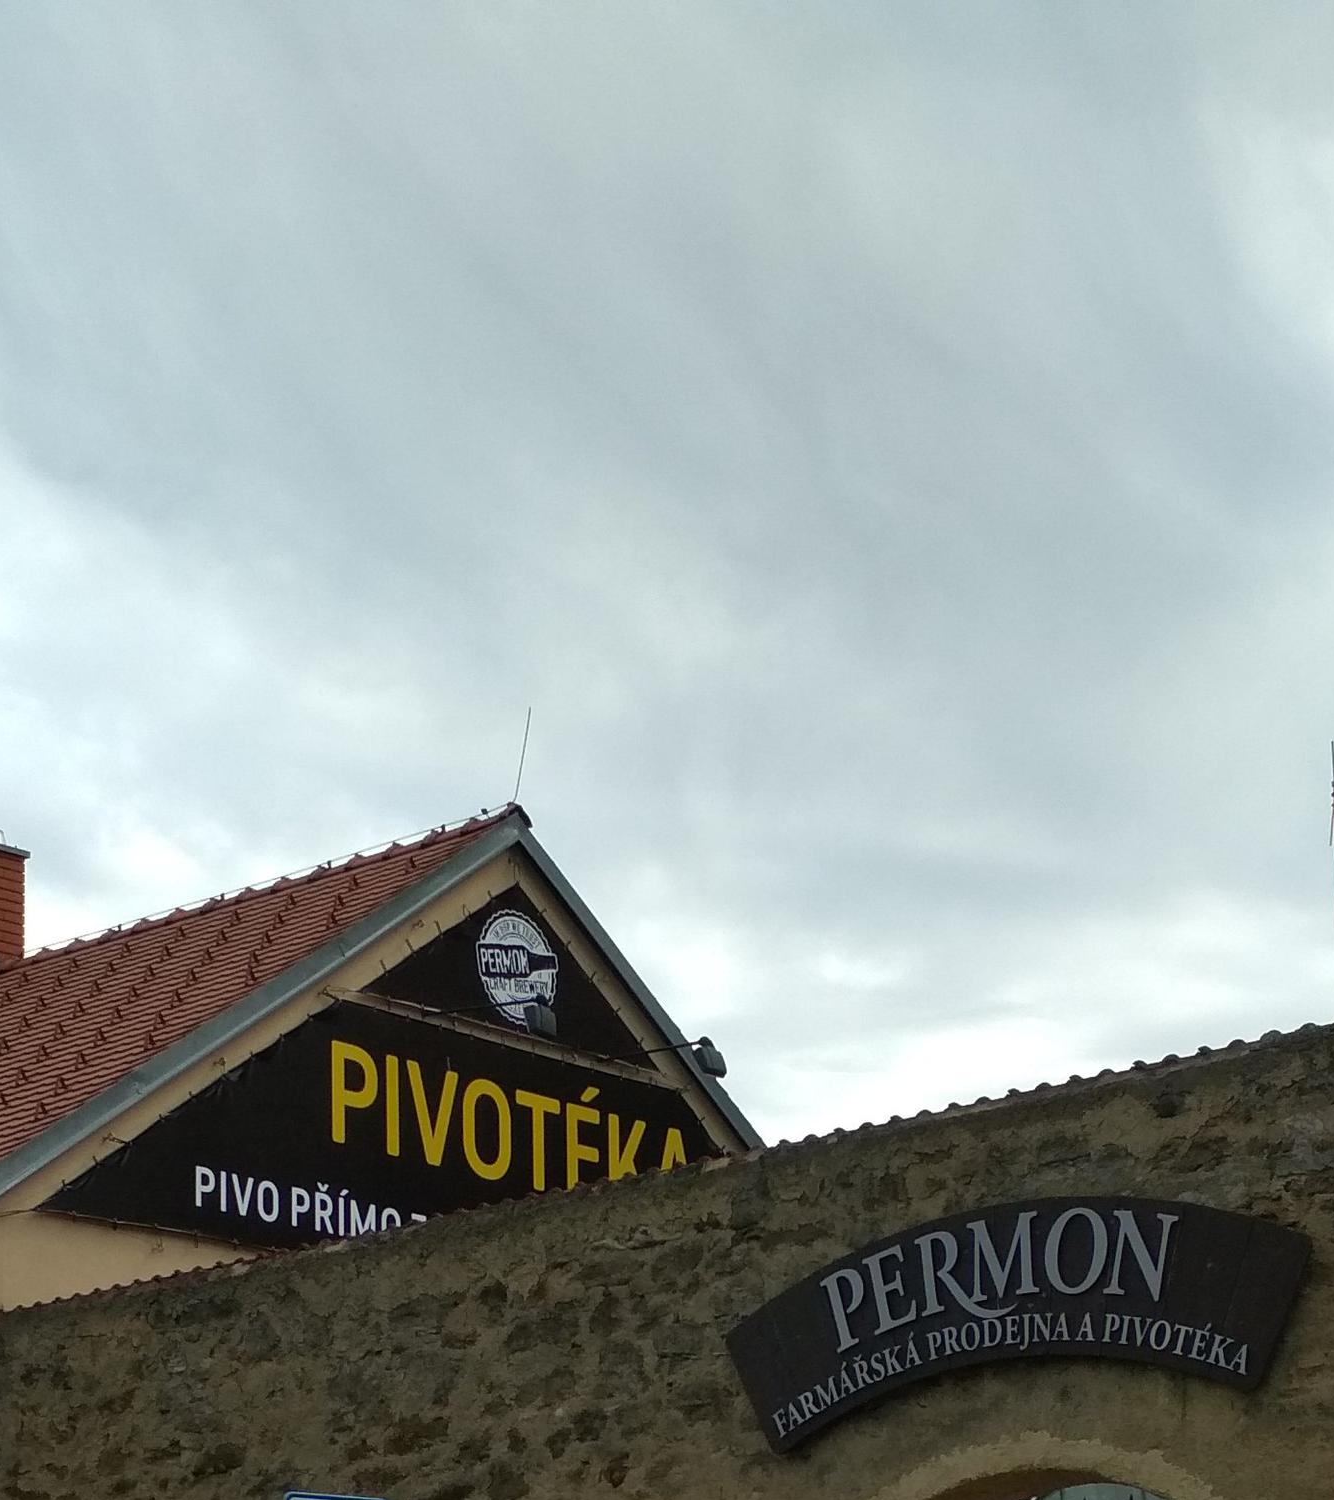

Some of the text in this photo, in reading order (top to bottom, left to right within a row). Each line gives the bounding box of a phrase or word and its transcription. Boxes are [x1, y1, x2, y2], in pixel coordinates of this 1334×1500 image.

[480, 948, 529, 974] PERMON
[195, 1165, 279, 1223] PIVO
[820, 1207, 1179, 1353] PERMON
[772, 1311, 1249, 1438] FARMÁŘSKÁ PRODEJNA A PIVOTÉKA
